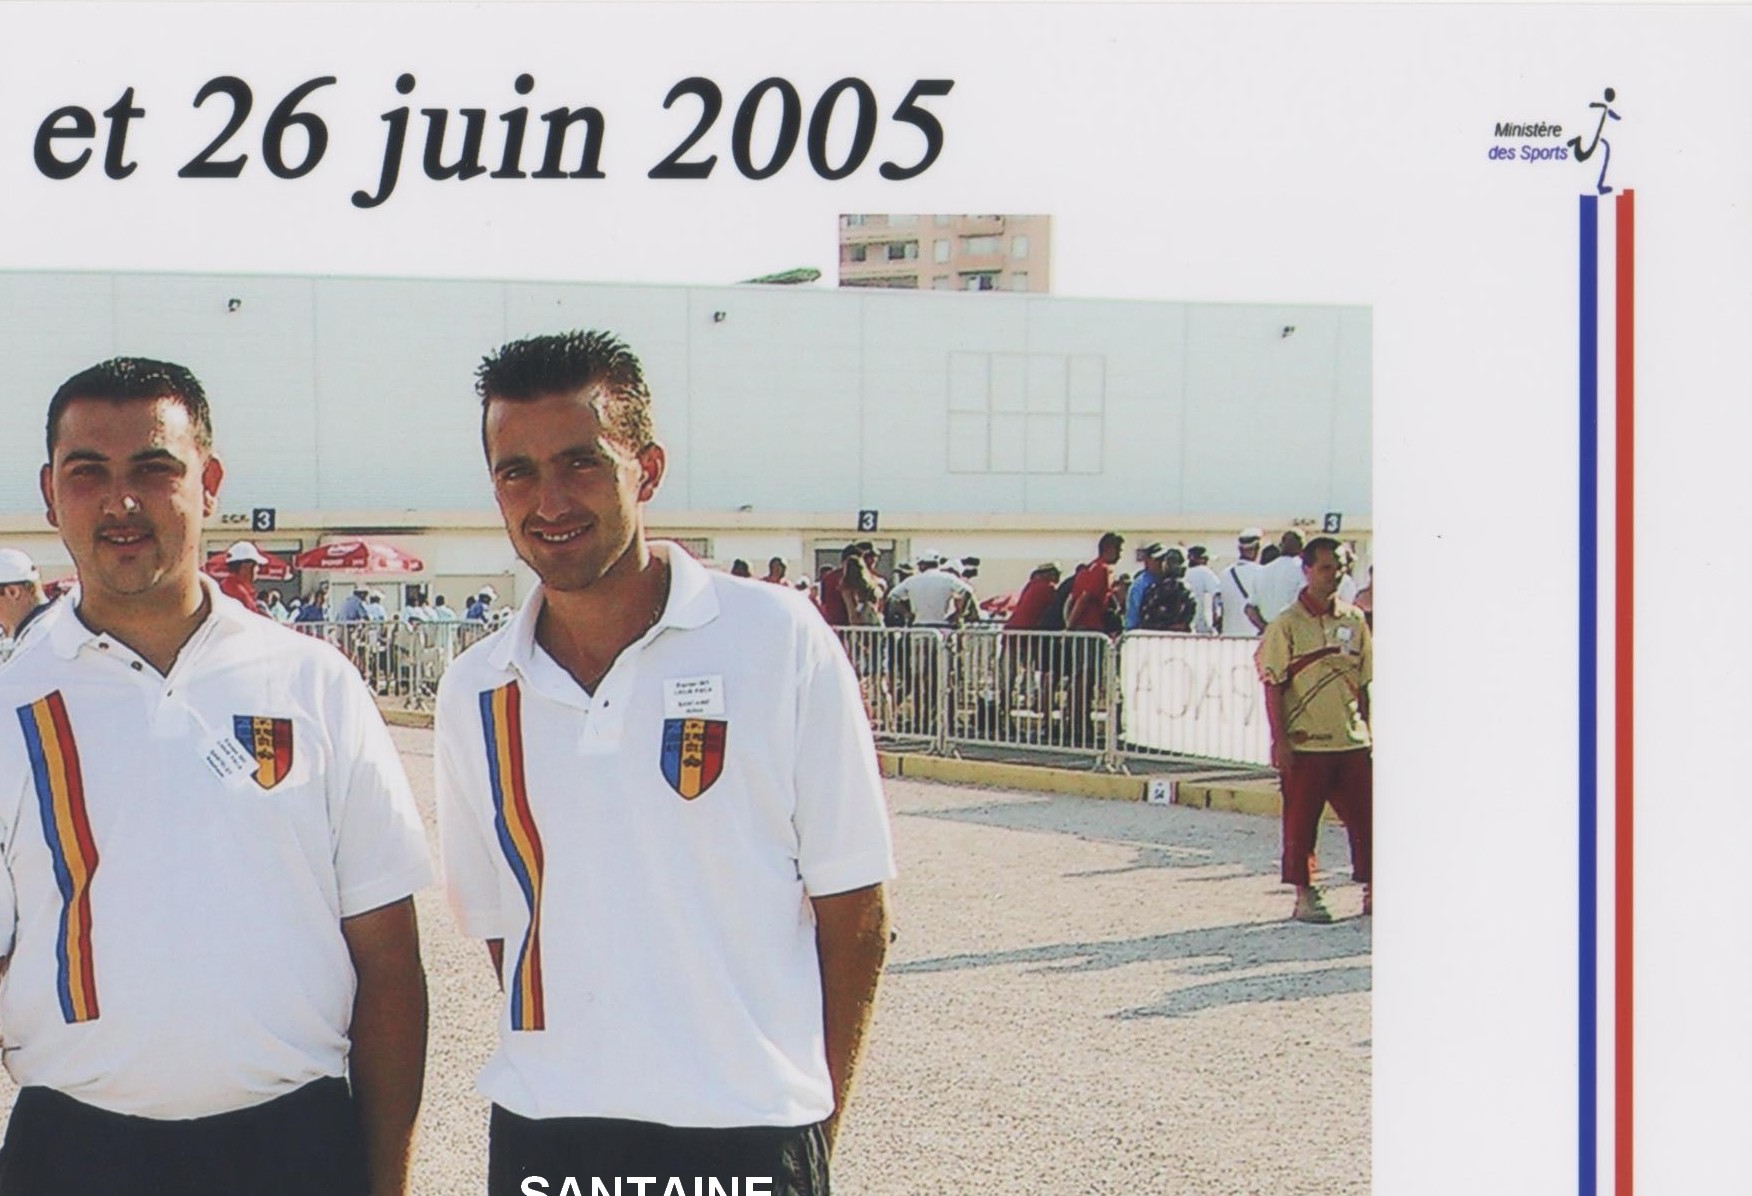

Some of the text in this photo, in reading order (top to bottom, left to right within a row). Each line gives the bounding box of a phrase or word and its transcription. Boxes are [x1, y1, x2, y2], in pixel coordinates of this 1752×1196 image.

[257, 511, 271, 529] 3
[863, 512, 874, 530] 3
[1327, 515, 1339, 532] 3
